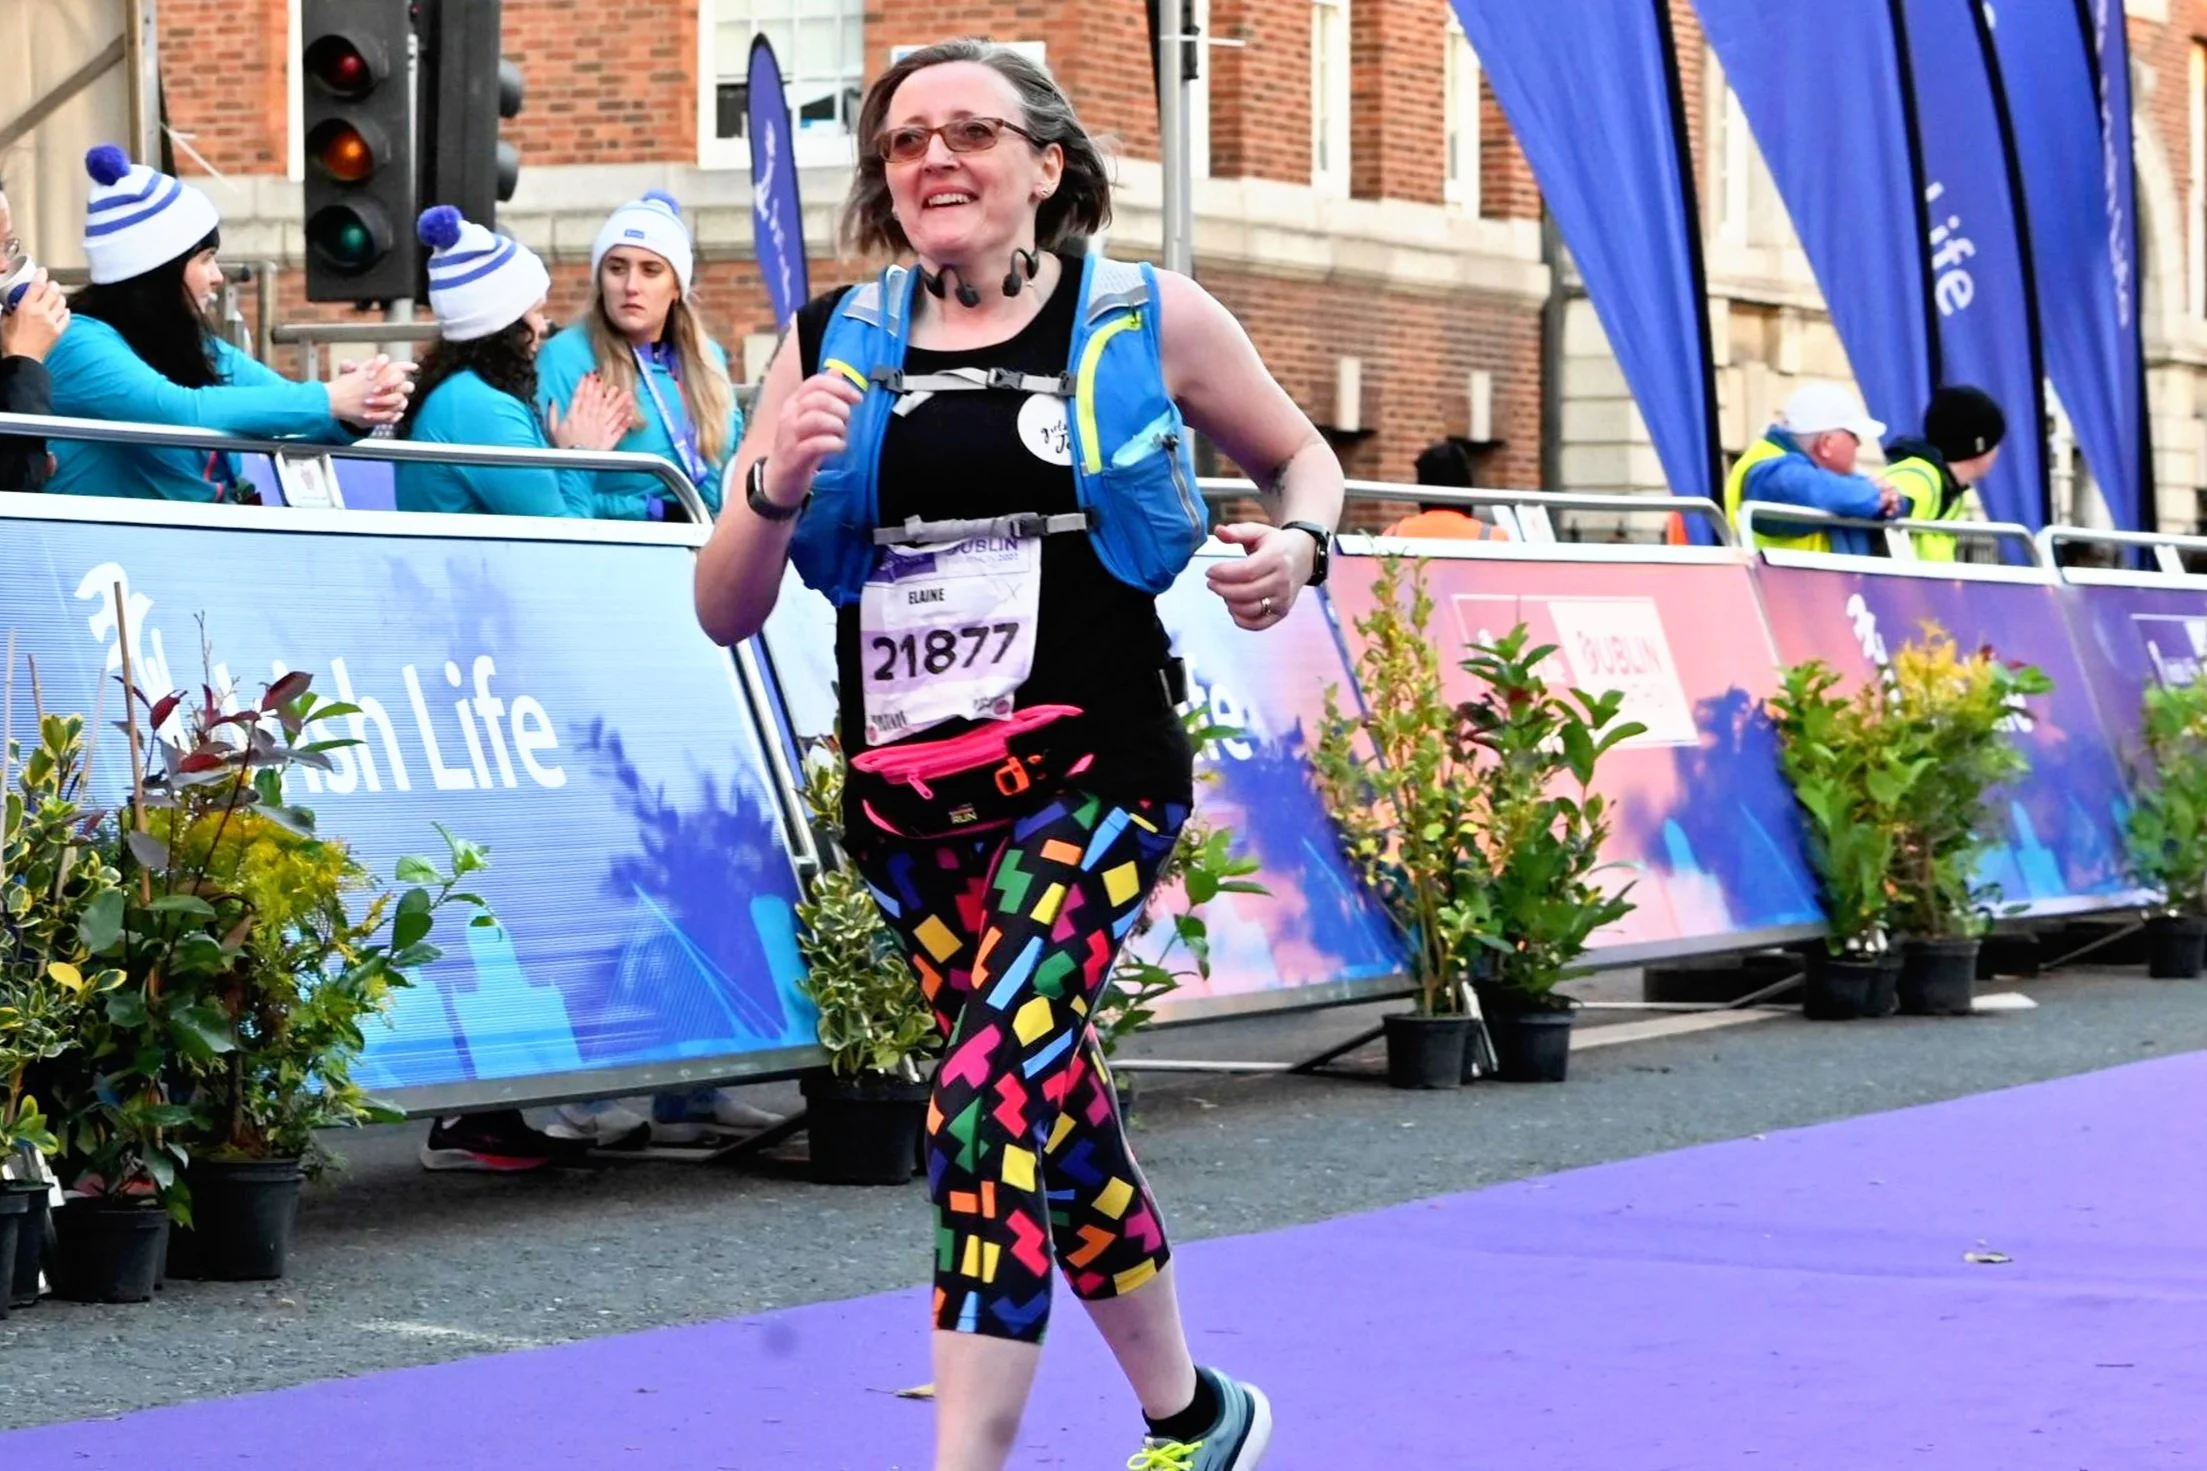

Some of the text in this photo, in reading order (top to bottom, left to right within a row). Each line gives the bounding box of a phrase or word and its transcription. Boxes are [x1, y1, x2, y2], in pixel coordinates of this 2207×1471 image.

[908, 588, 945, 605] ELAINE
[873, 622, 1019, 681] 21877
[402, 655, 567, 791] Life
